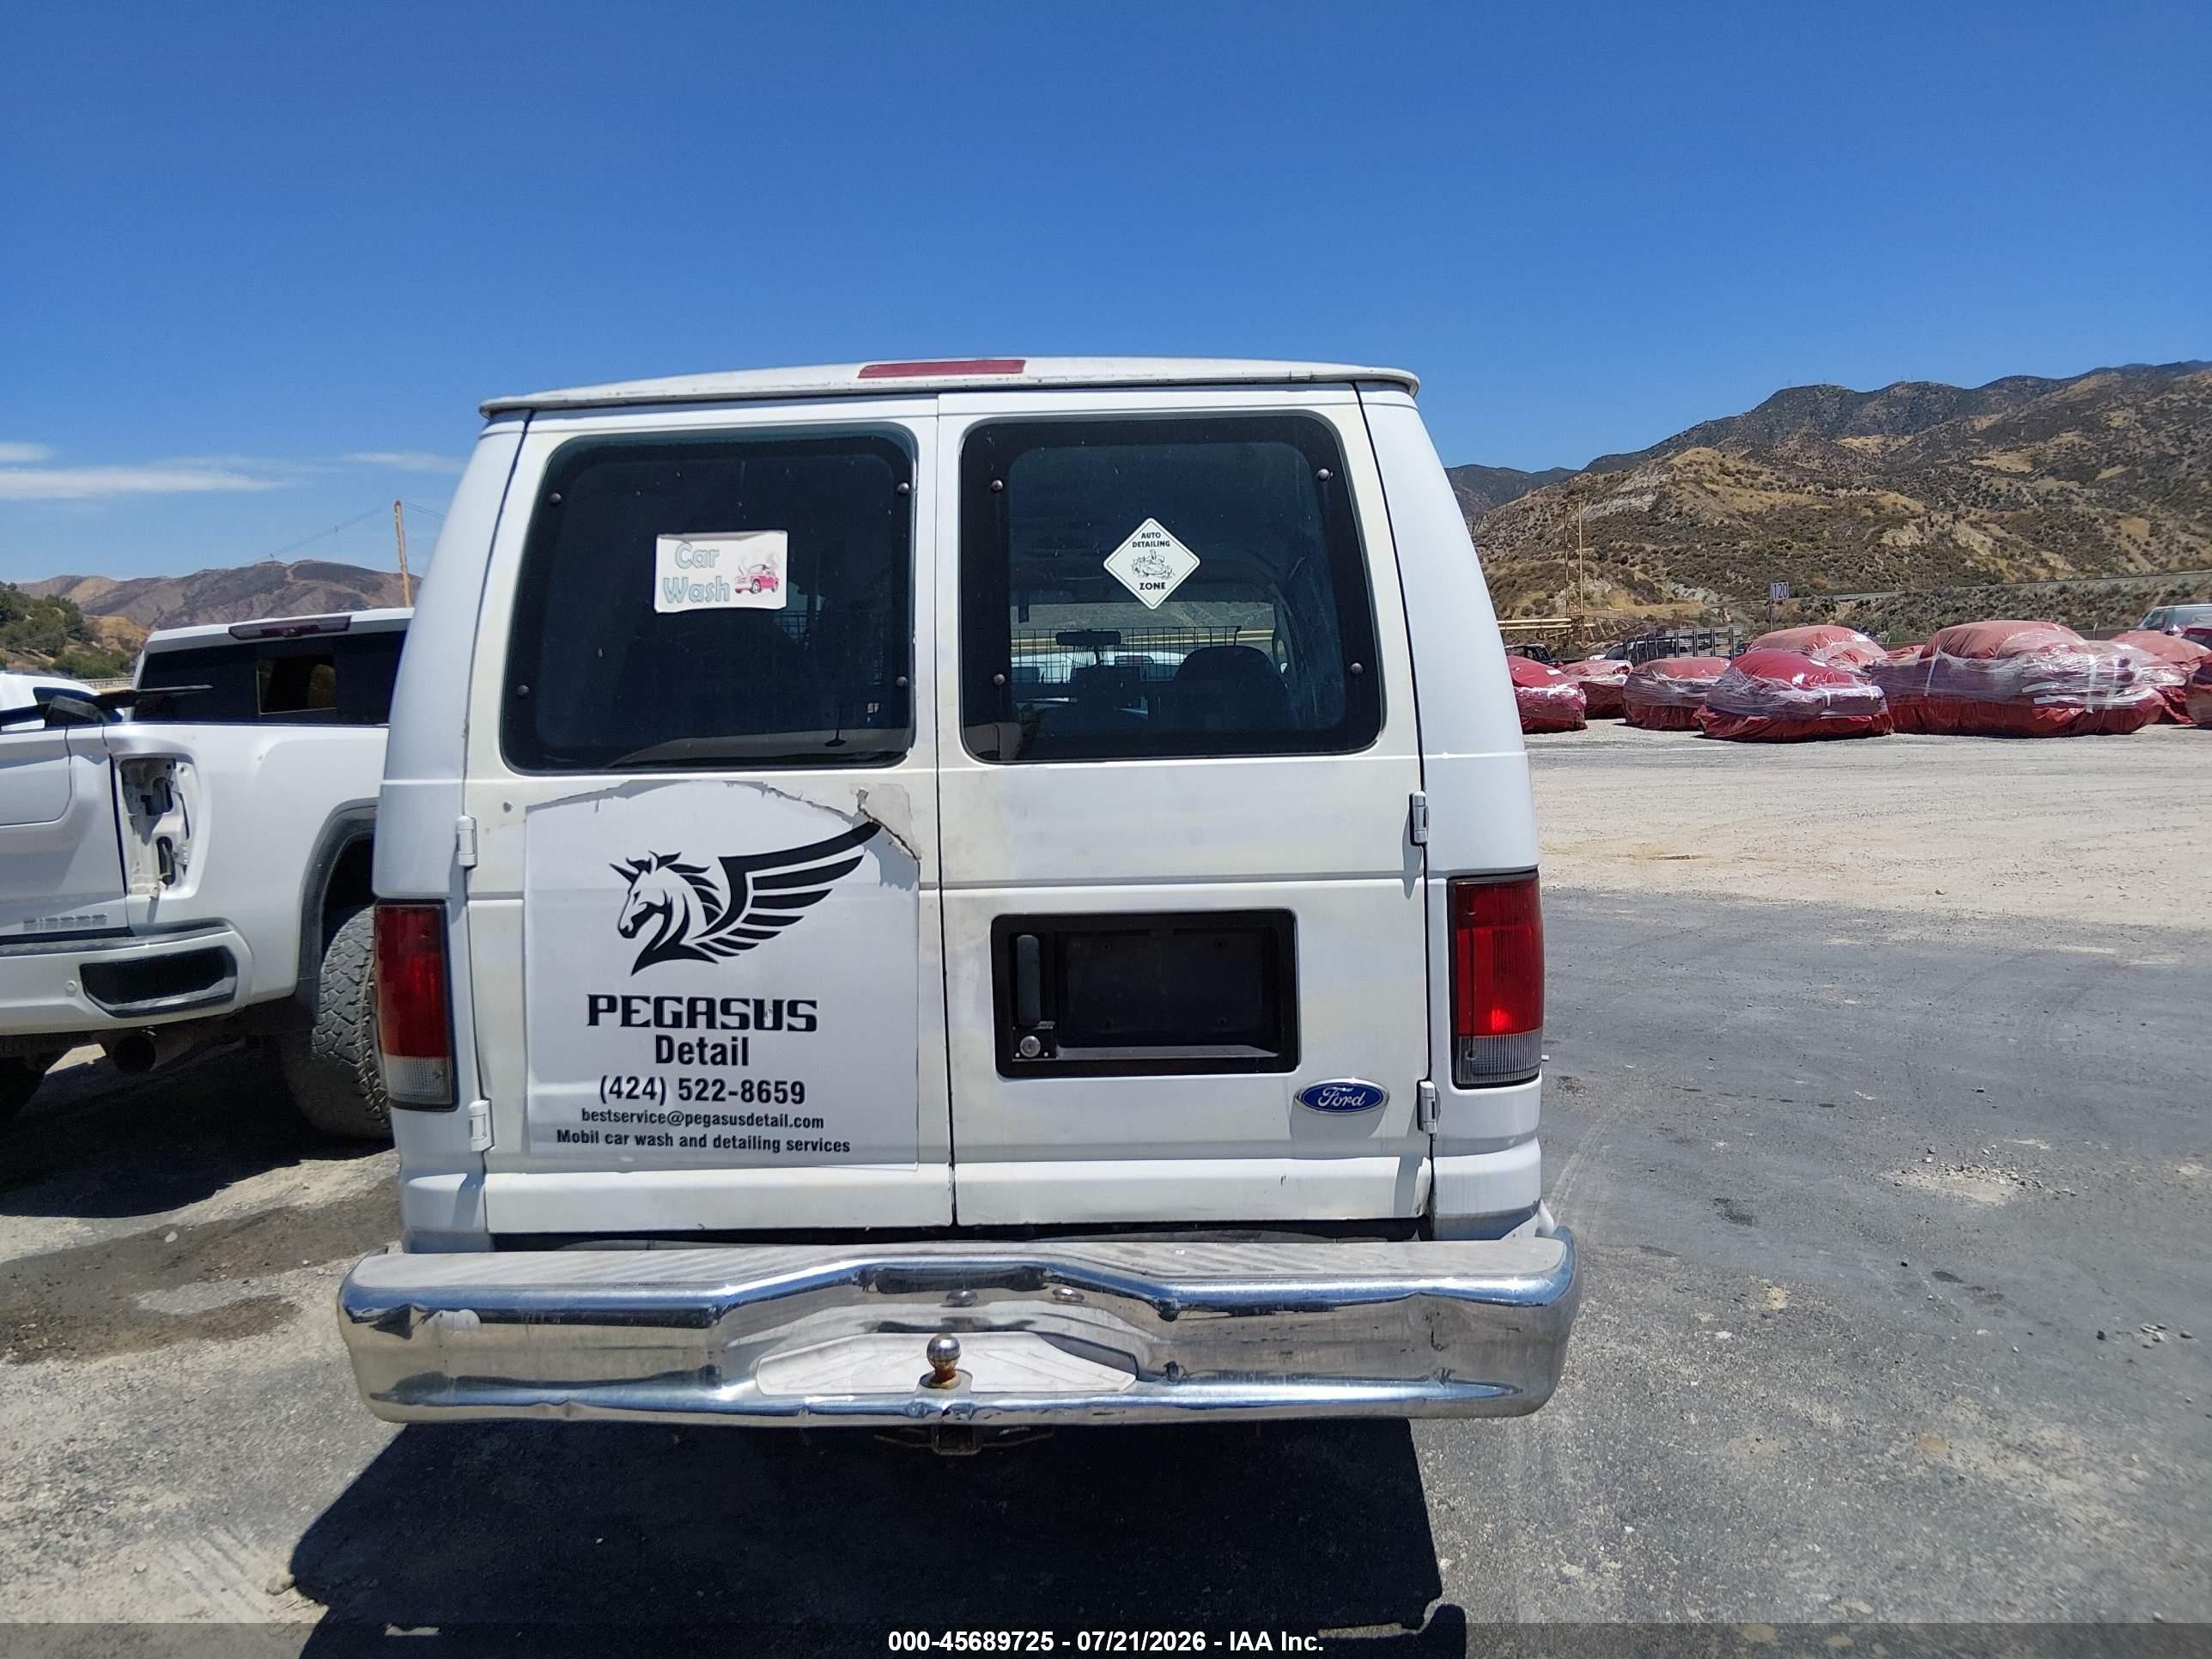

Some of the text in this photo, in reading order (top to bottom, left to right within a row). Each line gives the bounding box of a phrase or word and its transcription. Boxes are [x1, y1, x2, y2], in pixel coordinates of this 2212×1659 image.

[676, 542, 720, 569] Car
[663, 576, 730, 604] Wash
[1139, 582, 1166, 591] ZONE
[1773, 583, 1788, 599] 120
[586, 994, 817, 1032] PEGASUS
[655, 1034, 750, 1066] Detail
[600, 1074, 805, 1106] (424) 522-8659
[1317, 1086, 1366, 1107] Ford
[581, 1107, 824, 1129] bestservice@pegasusdetail.com
[557, 1129, 851, 1153] Mobil car wash and detailing services
